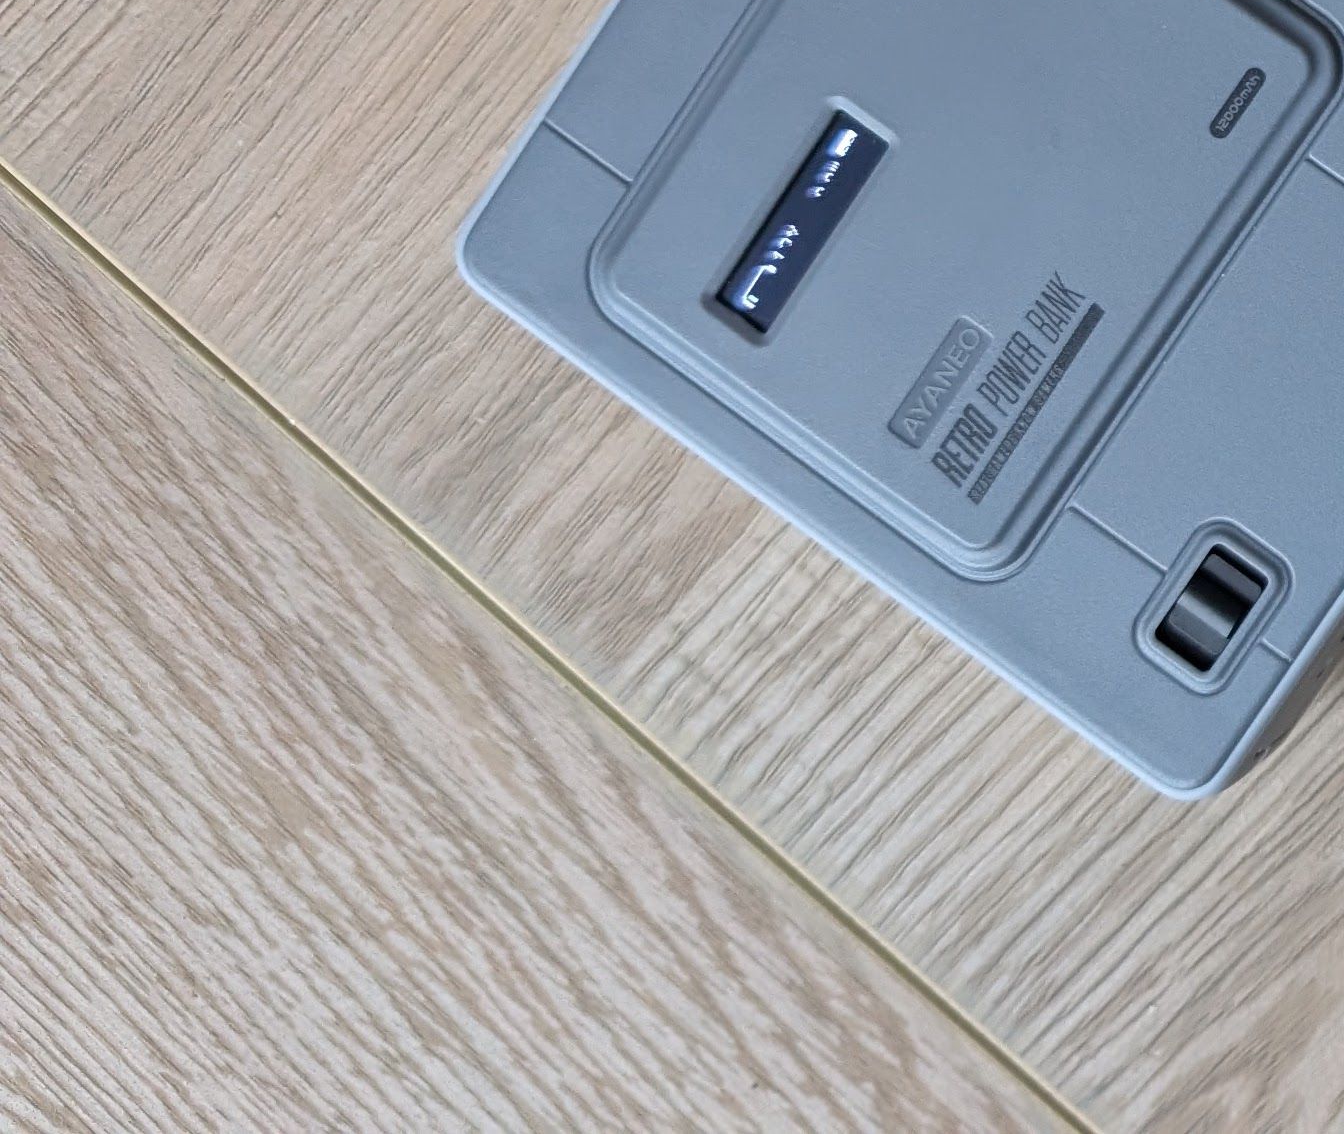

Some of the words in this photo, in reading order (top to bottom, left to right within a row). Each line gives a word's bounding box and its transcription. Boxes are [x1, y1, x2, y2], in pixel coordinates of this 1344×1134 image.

[902, 327, 981, 440] AYANEO
[930, 402, 999, 489] RETRO
[975, 329, 1047, 418] POWER
[1024, 270, 1087, 345] BANK
